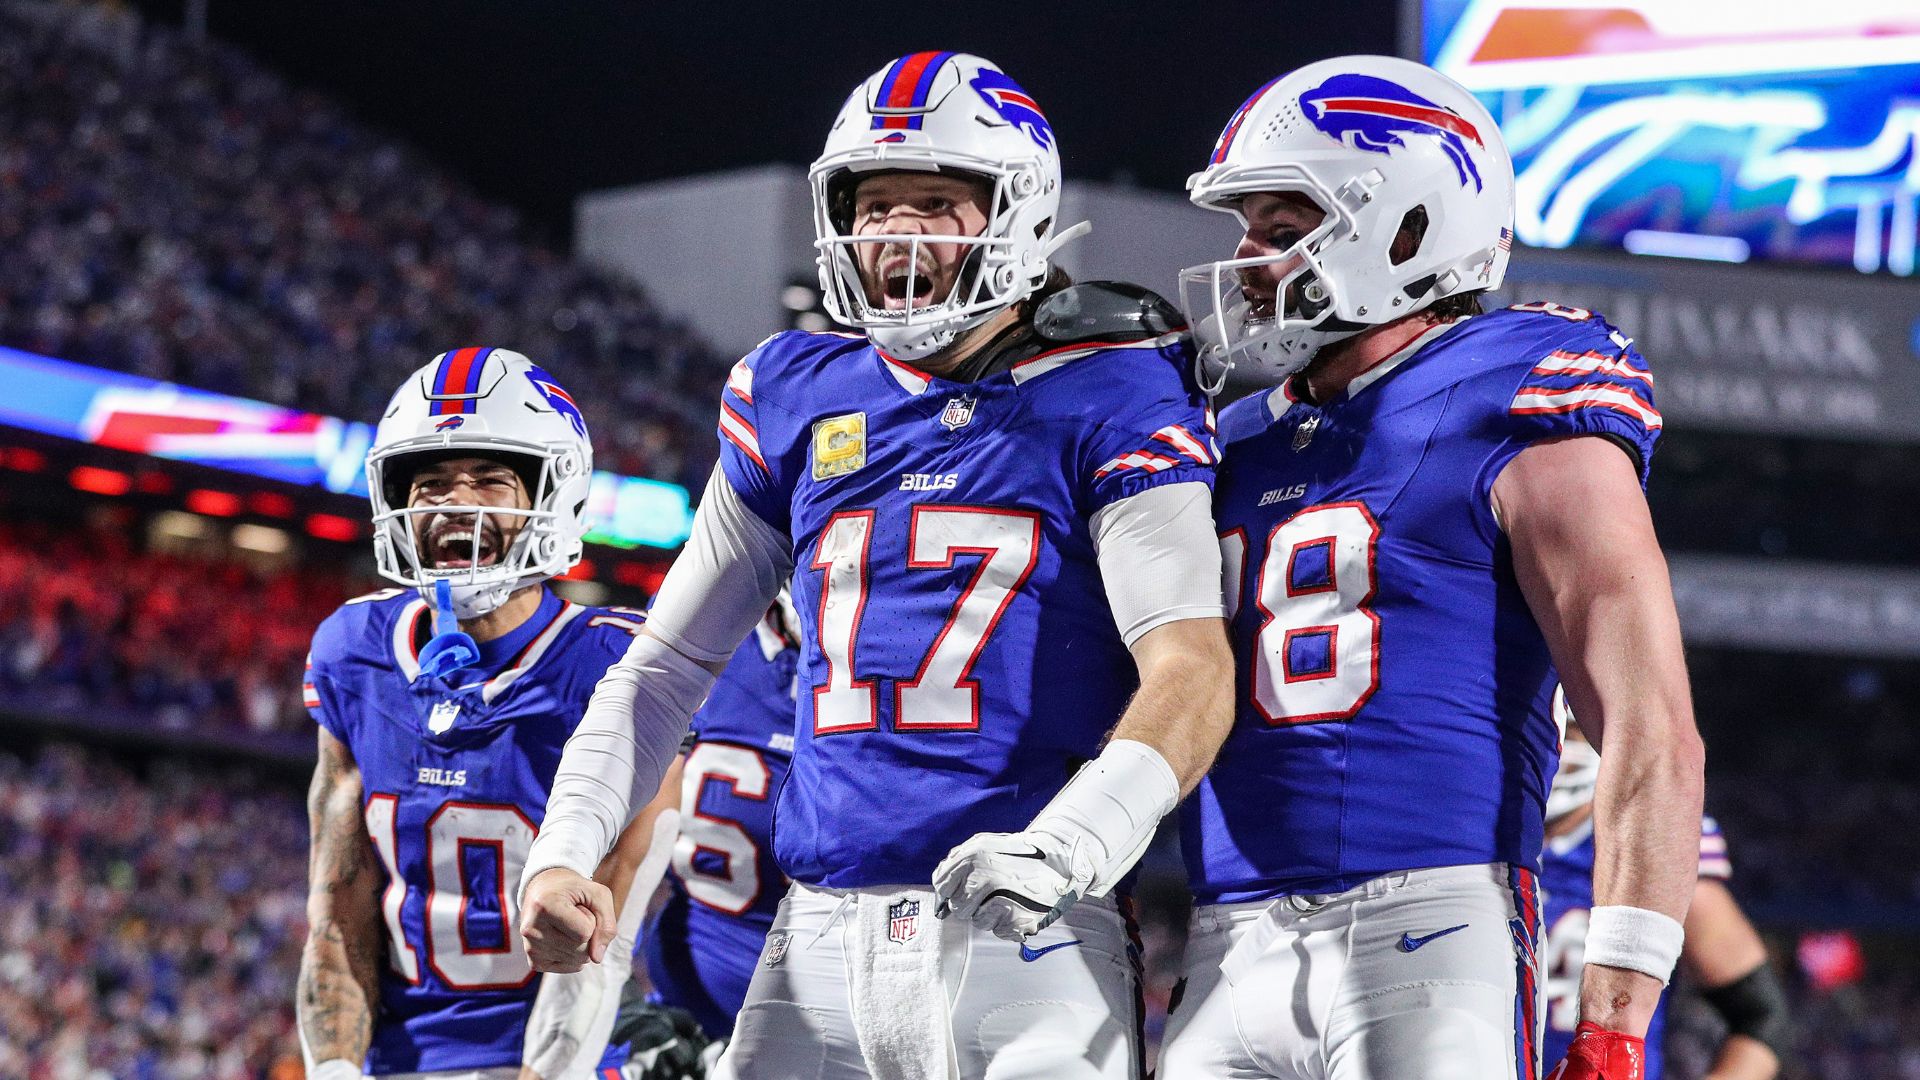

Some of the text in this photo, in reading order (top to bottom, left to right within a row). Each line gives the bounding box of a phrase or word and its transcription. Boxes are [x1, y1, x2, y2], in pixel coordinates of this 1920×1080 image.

[946, 410, 969, 424] NFL
[816, 418, 862, 464] C
[899, 473, 959, 492] BILLS
[1257, 482, 1308, 507] BILLS
[810, 502, 1042, 737] 17
[1219, 500, 1383, 727] 8
[417, 767, 467, 787] BILLS
[365, 792, 540, 990] 10
[891, 917, 917, 941] NFL
